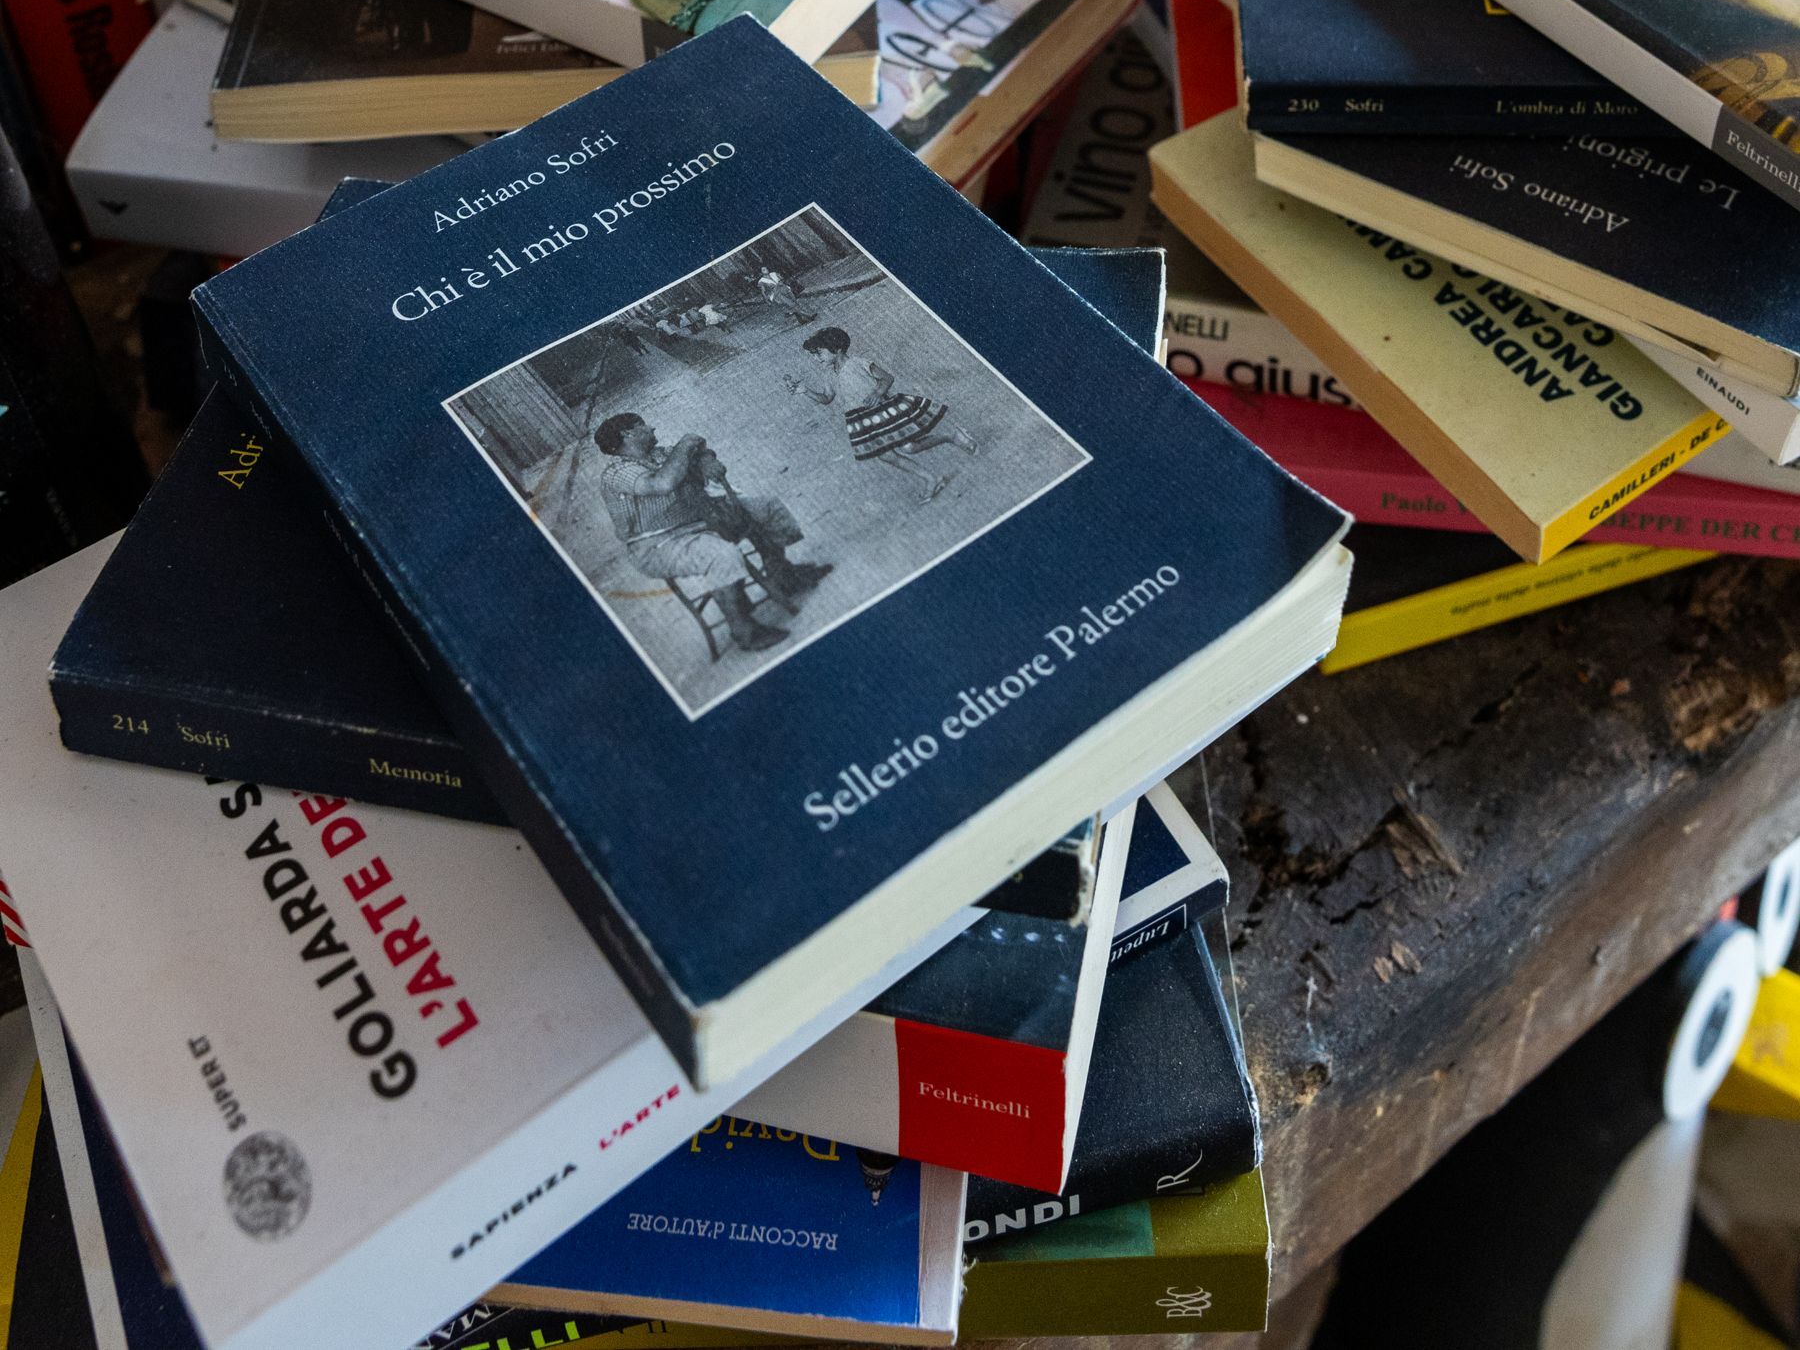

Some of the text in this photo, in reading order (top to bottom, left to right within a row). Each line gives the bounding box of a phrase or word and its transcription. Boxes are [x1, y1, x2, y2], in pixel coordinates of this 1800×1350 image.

[1344, 97, 1385, 113] Sofri
[1568, 100, 1588, 116] di
[431, 128, 619, 234] Adriano Sofri
[1053, 104, 1156, 223] vino
[1449, 154, 1631, 234] Adriano Sofri
[1697, 176, 1743, 212] Le
[391, 140, 737, 322] Chi è il mio prossimo
[1338, 215, 1577, 403] ANDREA CAM
[1695, 366, 1750, 416] EINAUDI
[217, 432, 264, 490] Adr
[1587, 451, 1677, 522] CAMILLERI
[1689, 426, 1712, 451] DE
[1379, 491, 1447, 515] Paolo
[112, 714, 231, 750] 214 Sofri
[803, 563, 1182, 834] Sellerio editore Palermo
[368, 757, 463, 790] Memoria
[291, 789, 481, 1050] L'ARTE DE
[243, 817, 419, 1101] GOLIARDA
[200, 1056, 247, 1134] SUPER
[917, 1080, 1031, 1120] Feltrinelli
[451, 1083, 681, 1260] SAPIENZA L'ARTE
[627, 1212, 839, 1252] RACCONTI d'AUTORE
